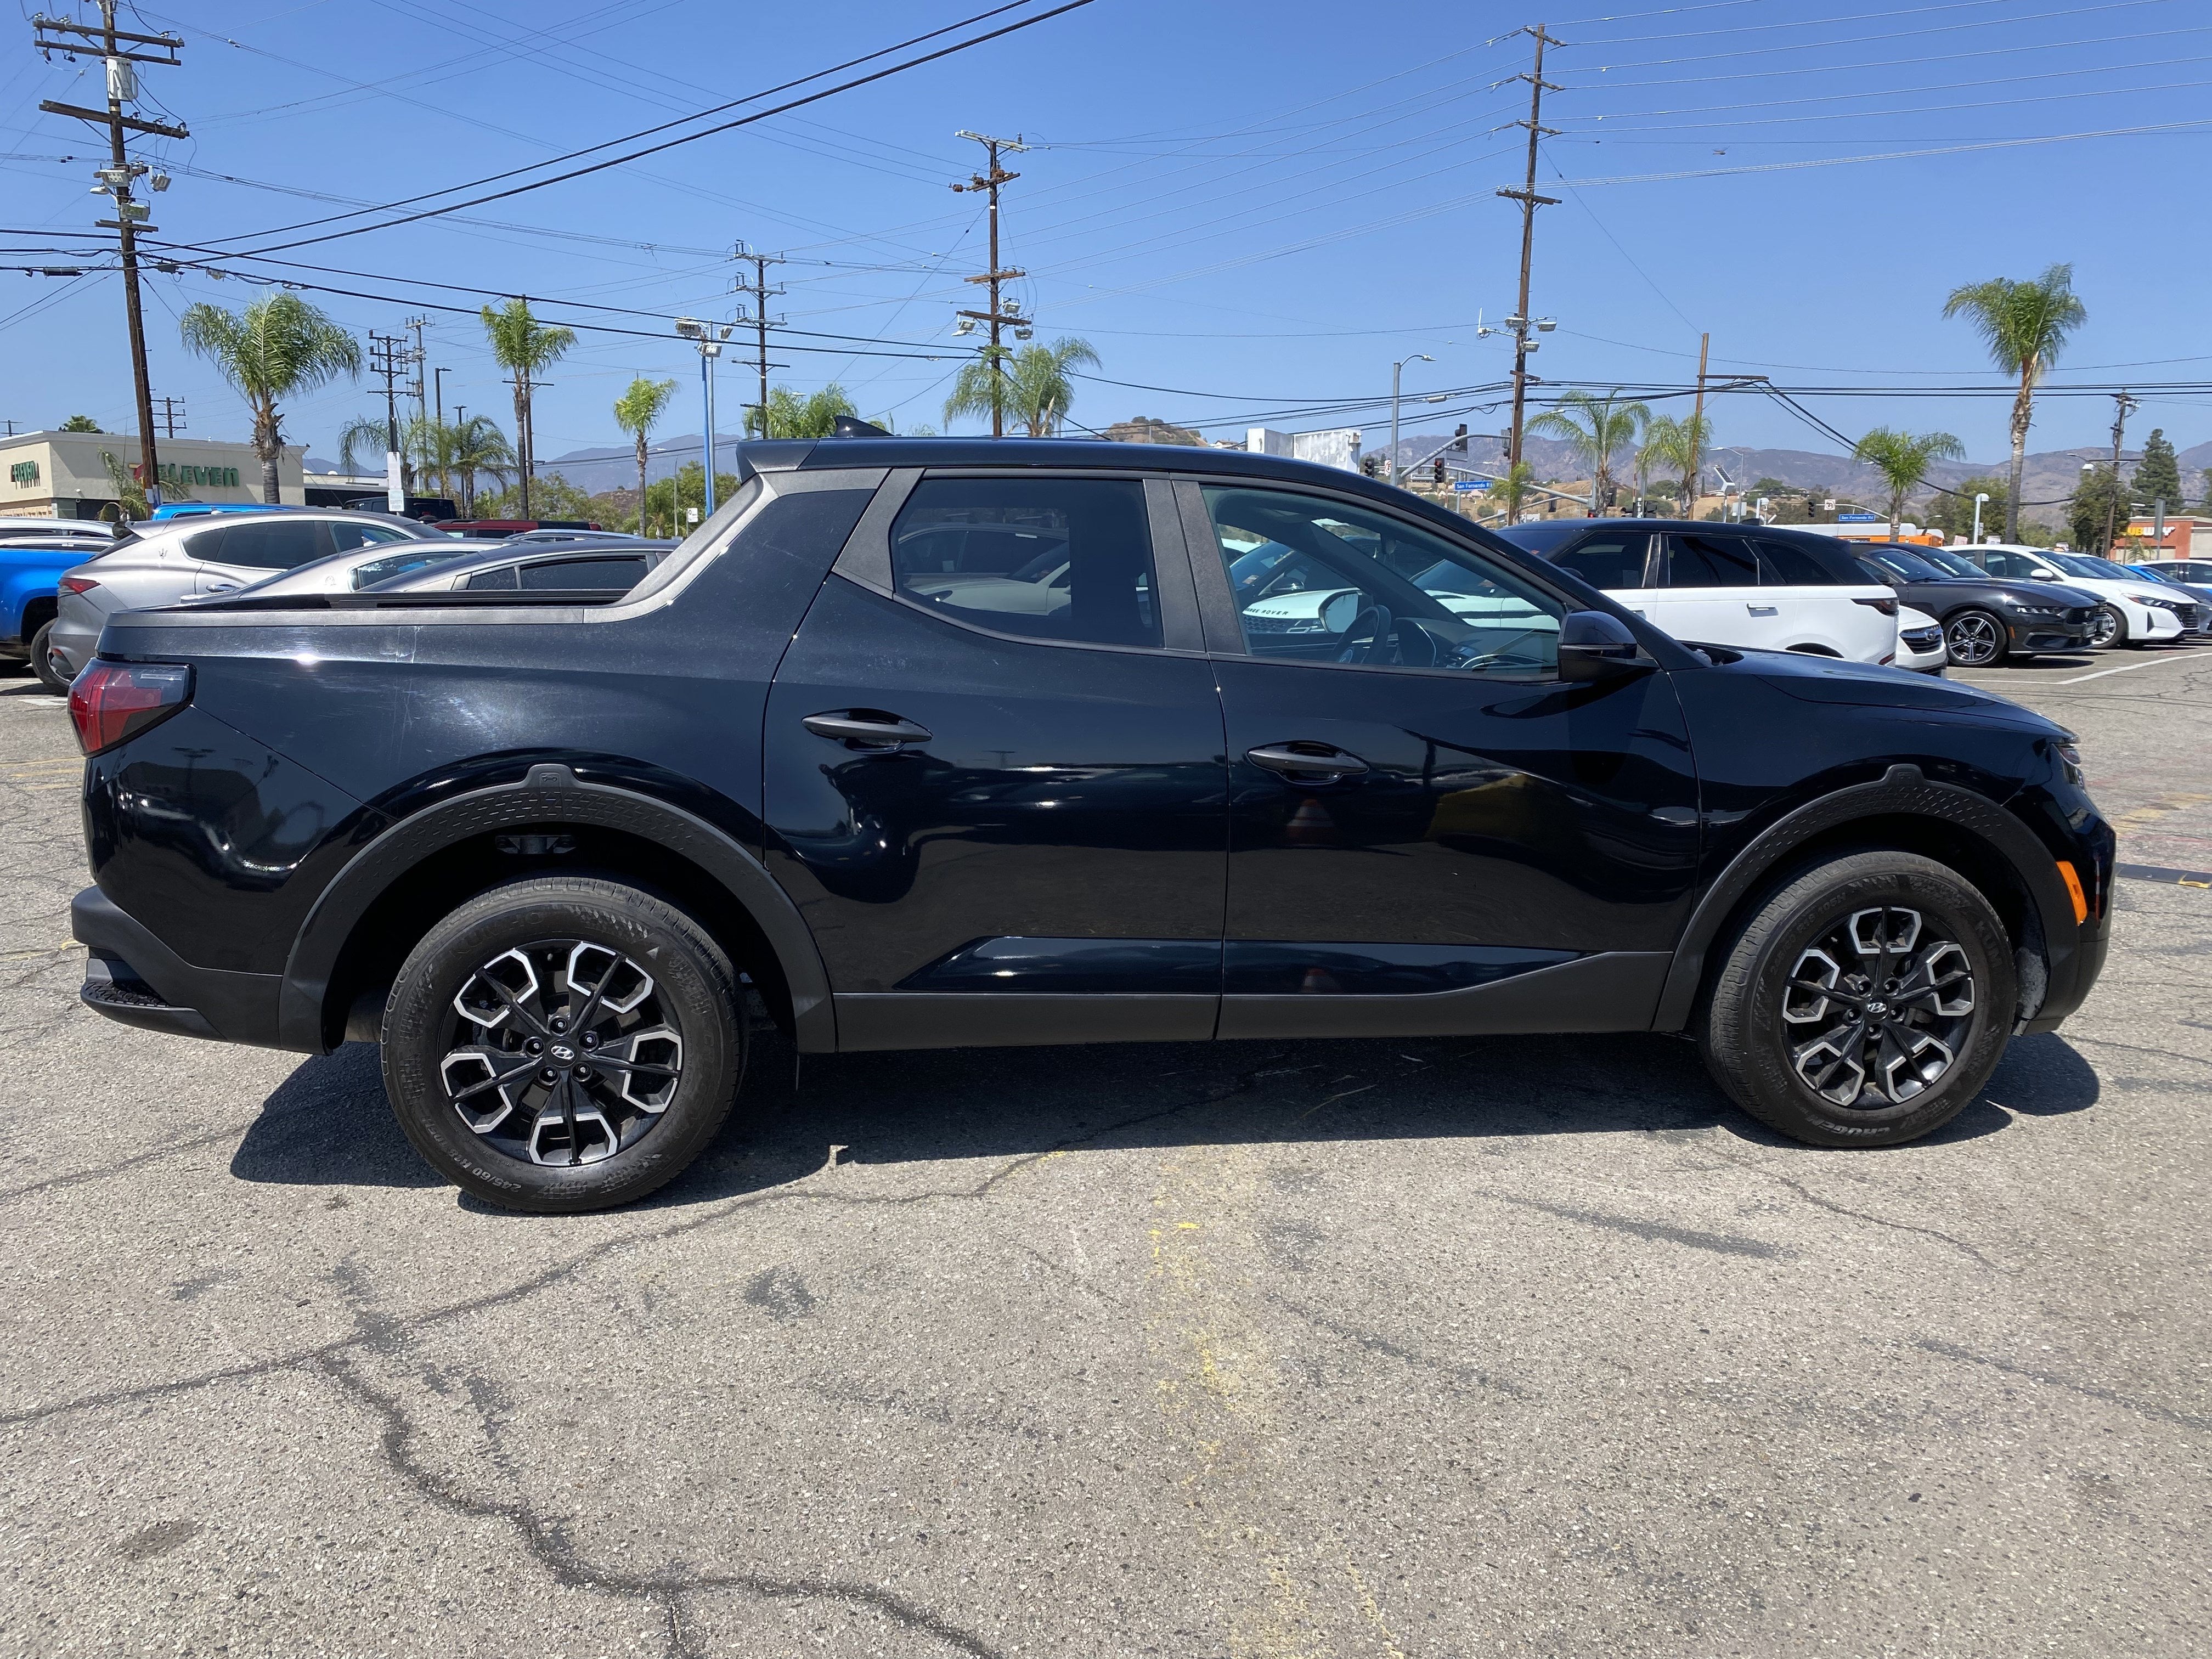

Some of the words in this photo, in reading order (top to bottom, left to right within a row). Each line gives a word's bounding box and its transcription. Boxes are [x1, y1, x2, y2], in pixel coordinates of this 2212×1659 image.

[2126, 526, 2176, 537] UBWY
[447, 1147, 473, 1170] R18
[470, 1165, 522, 1194] 245/60
